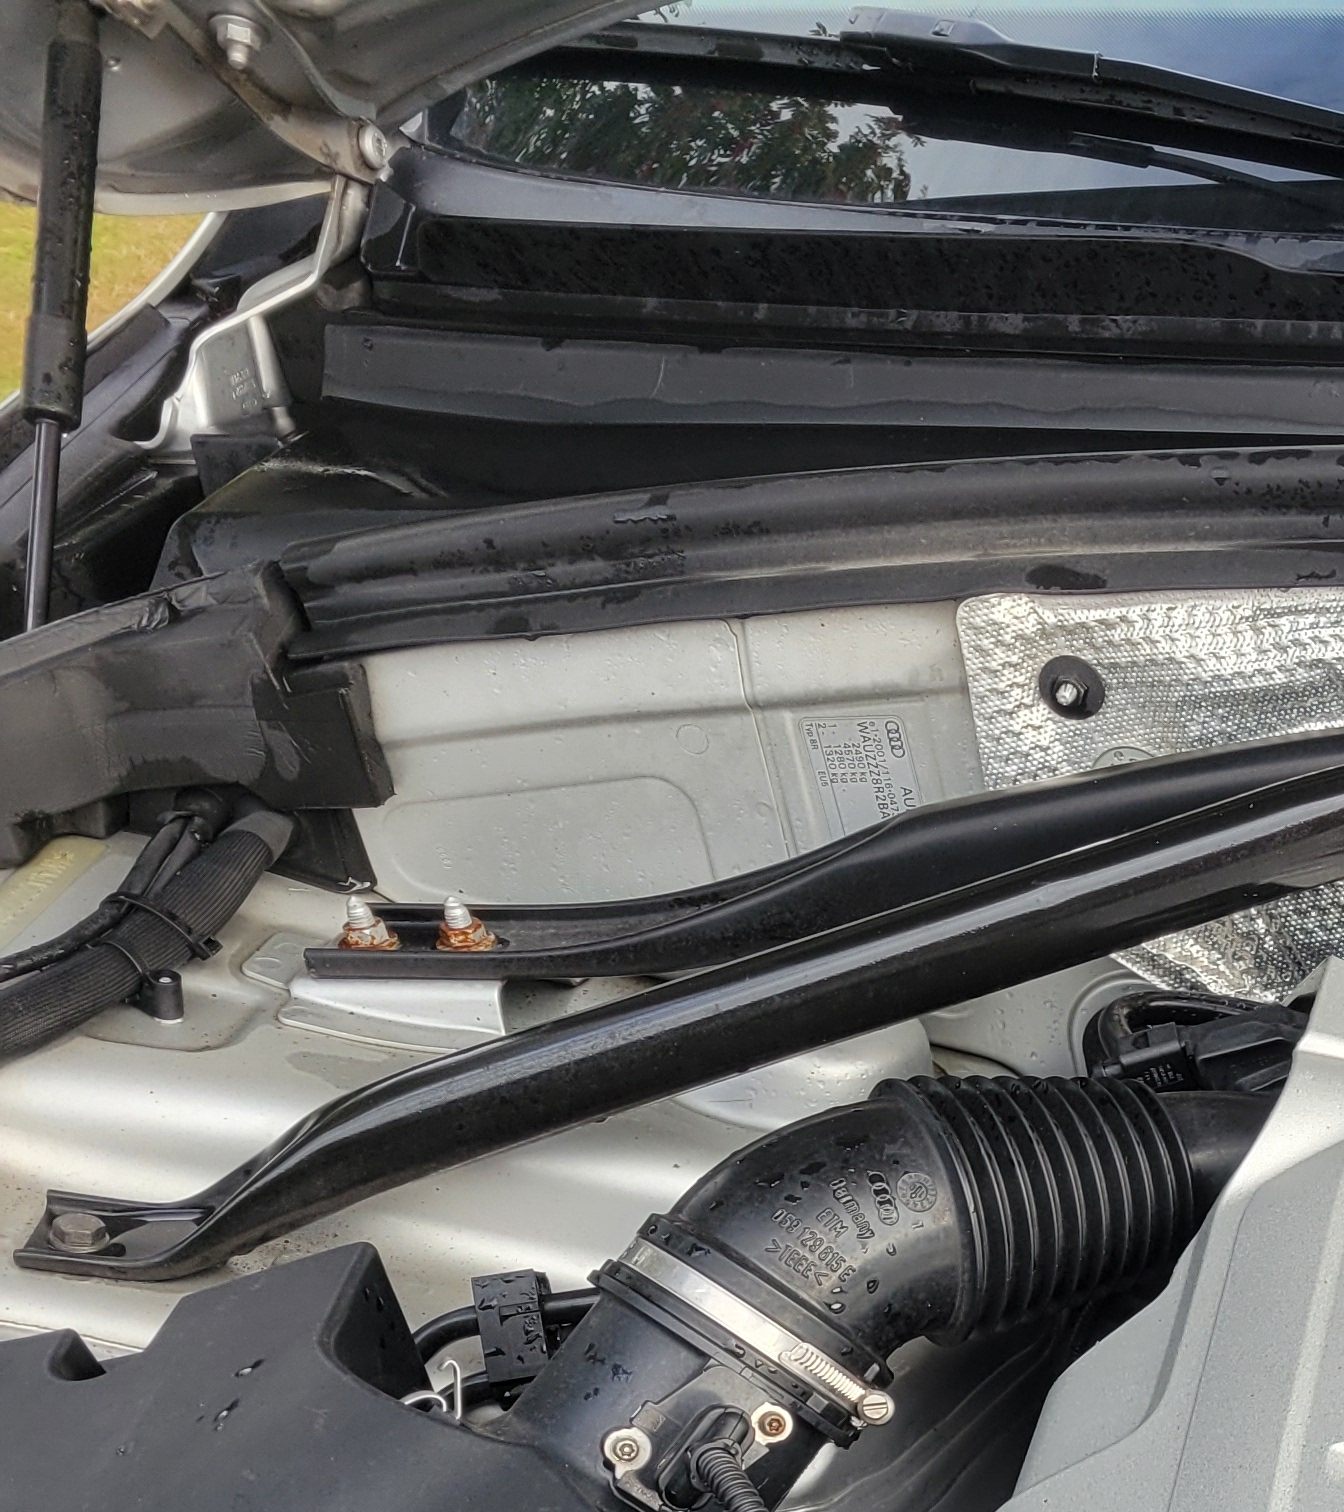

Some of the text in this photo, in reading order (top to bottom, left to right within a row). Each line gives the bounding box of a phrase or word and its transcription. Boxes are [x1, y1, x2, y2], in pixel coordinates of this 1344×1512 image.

[805, 722, 814, 738] Typ
[810, 739, 818, 750] 8R
[824, 745, 836, 769] 1320
[830, 772, 838, 784] kg
[833, 745, 846, 769] 1280
[840, 772, 848, 784] kg
[843, 743, 858, 783] 4570 kg
[852, 743, 868, 783] 2490 kg
[857, 721, 890, 820] WAUZZZ8R2BA
[771, 1208, 802, 1233] 059
[797, 1226, 824, 1252] 129
[818, 1246, 847, 1272] 615
[816, 1207, 849, 1238] ETM
